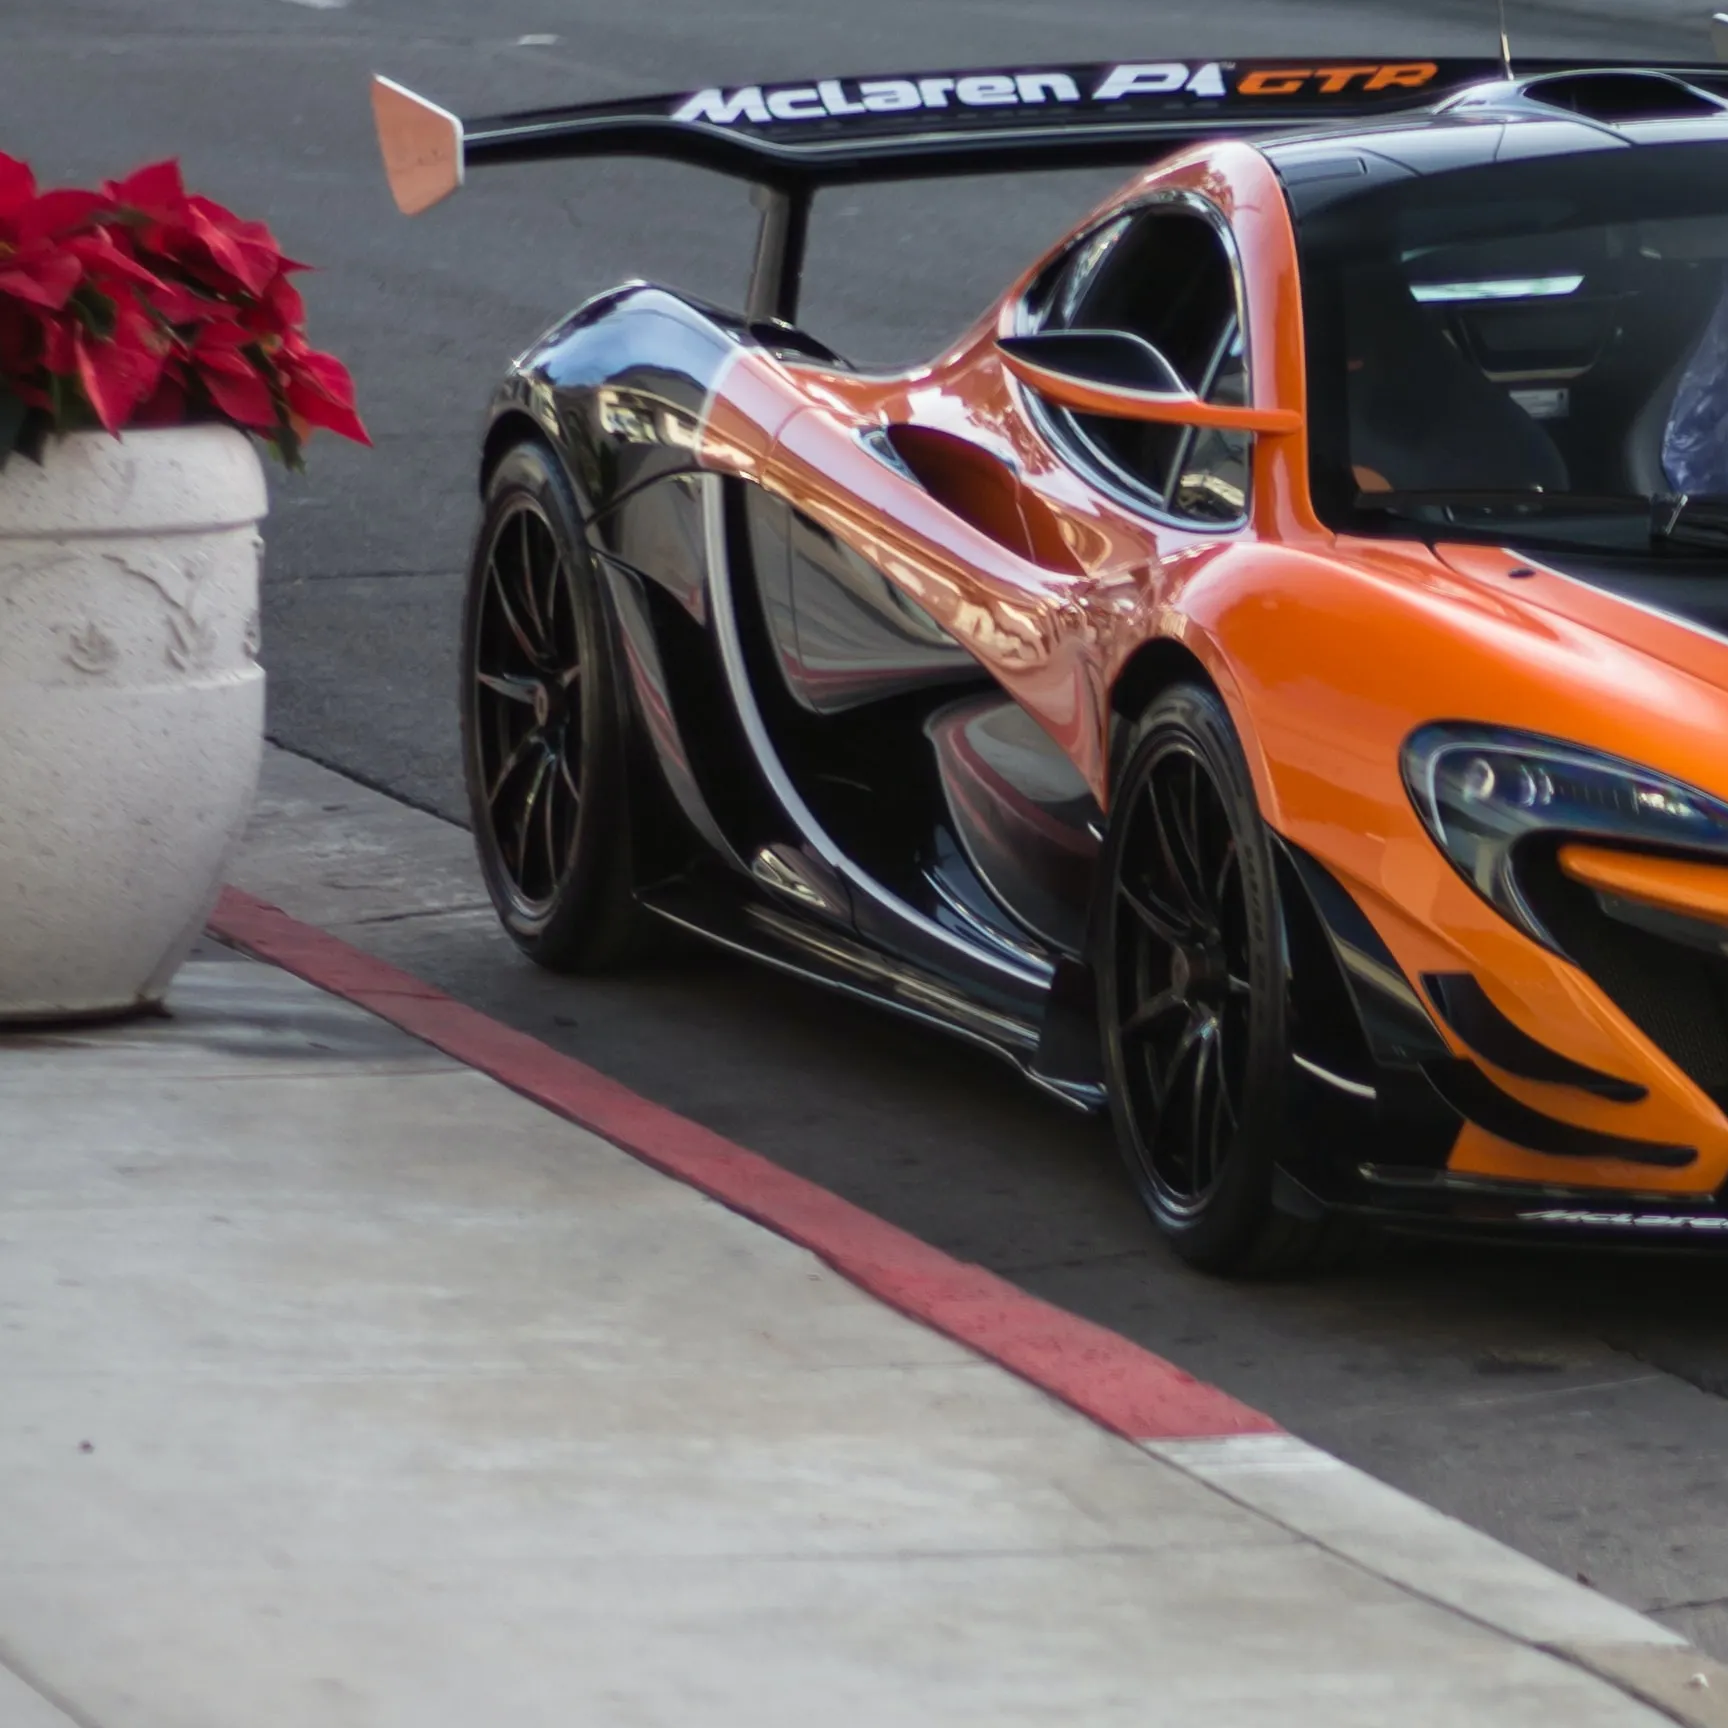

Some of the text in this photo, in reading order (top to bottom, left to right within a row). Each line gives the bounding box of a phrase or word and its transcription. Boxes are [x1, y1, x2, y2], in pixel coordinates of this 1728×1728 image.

[670, 62, 1439, 124] McLaren P1 GTR
